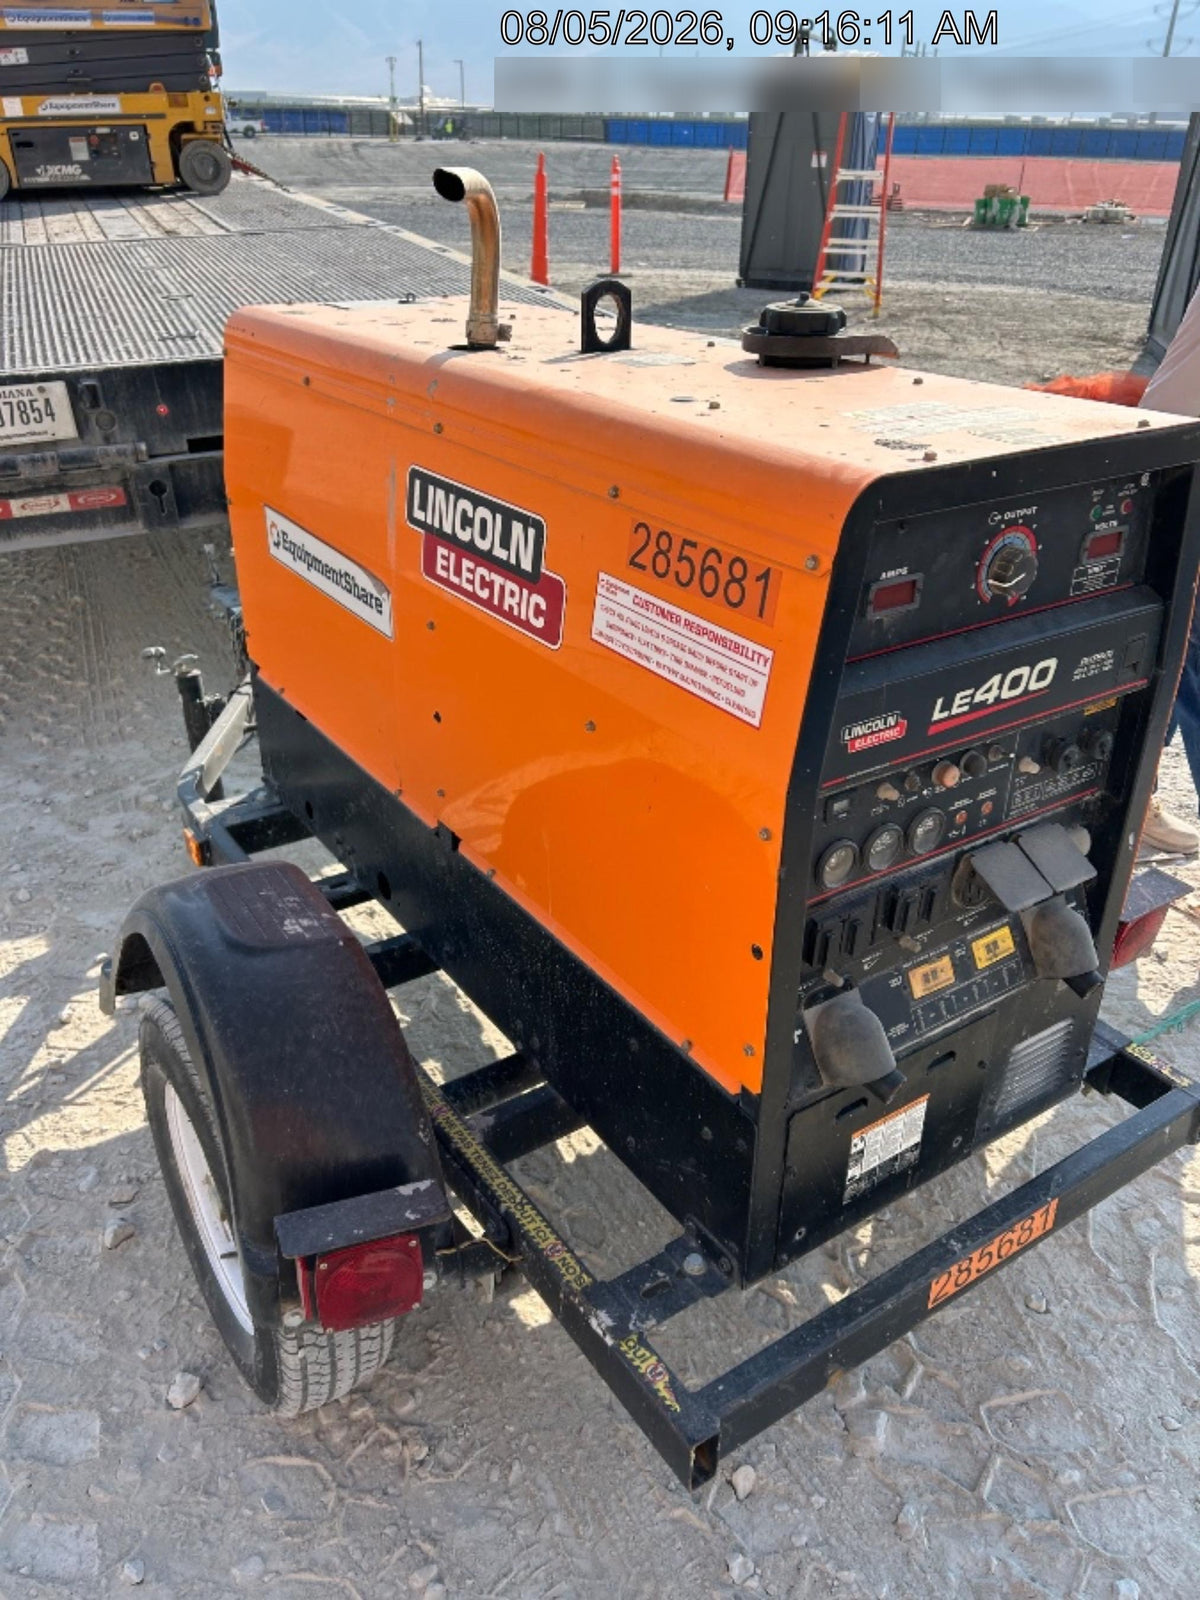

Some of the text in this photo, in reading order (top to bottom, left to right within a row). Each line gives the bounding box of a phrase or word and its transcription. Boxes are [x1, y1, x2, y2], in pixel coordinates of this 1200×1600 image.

[412, 478, 536, 574] LINCOLN
[280, 529, 384, 616] EquipmentShare
[435, 545, 547, 629] ELECTRIC
[628, 521, 772, 619] 285681
[632, 594, 682, 626] CUSTOMER
[683, 617, 771, 668] RESPONSIBILITY
[843, 714, 898, 741] LINCOLN
[931, 657, 1059, 722] LE400
[854, 726, 901, 749] ELECTRIC
[931, 1205, 1050, 1305] 285681
